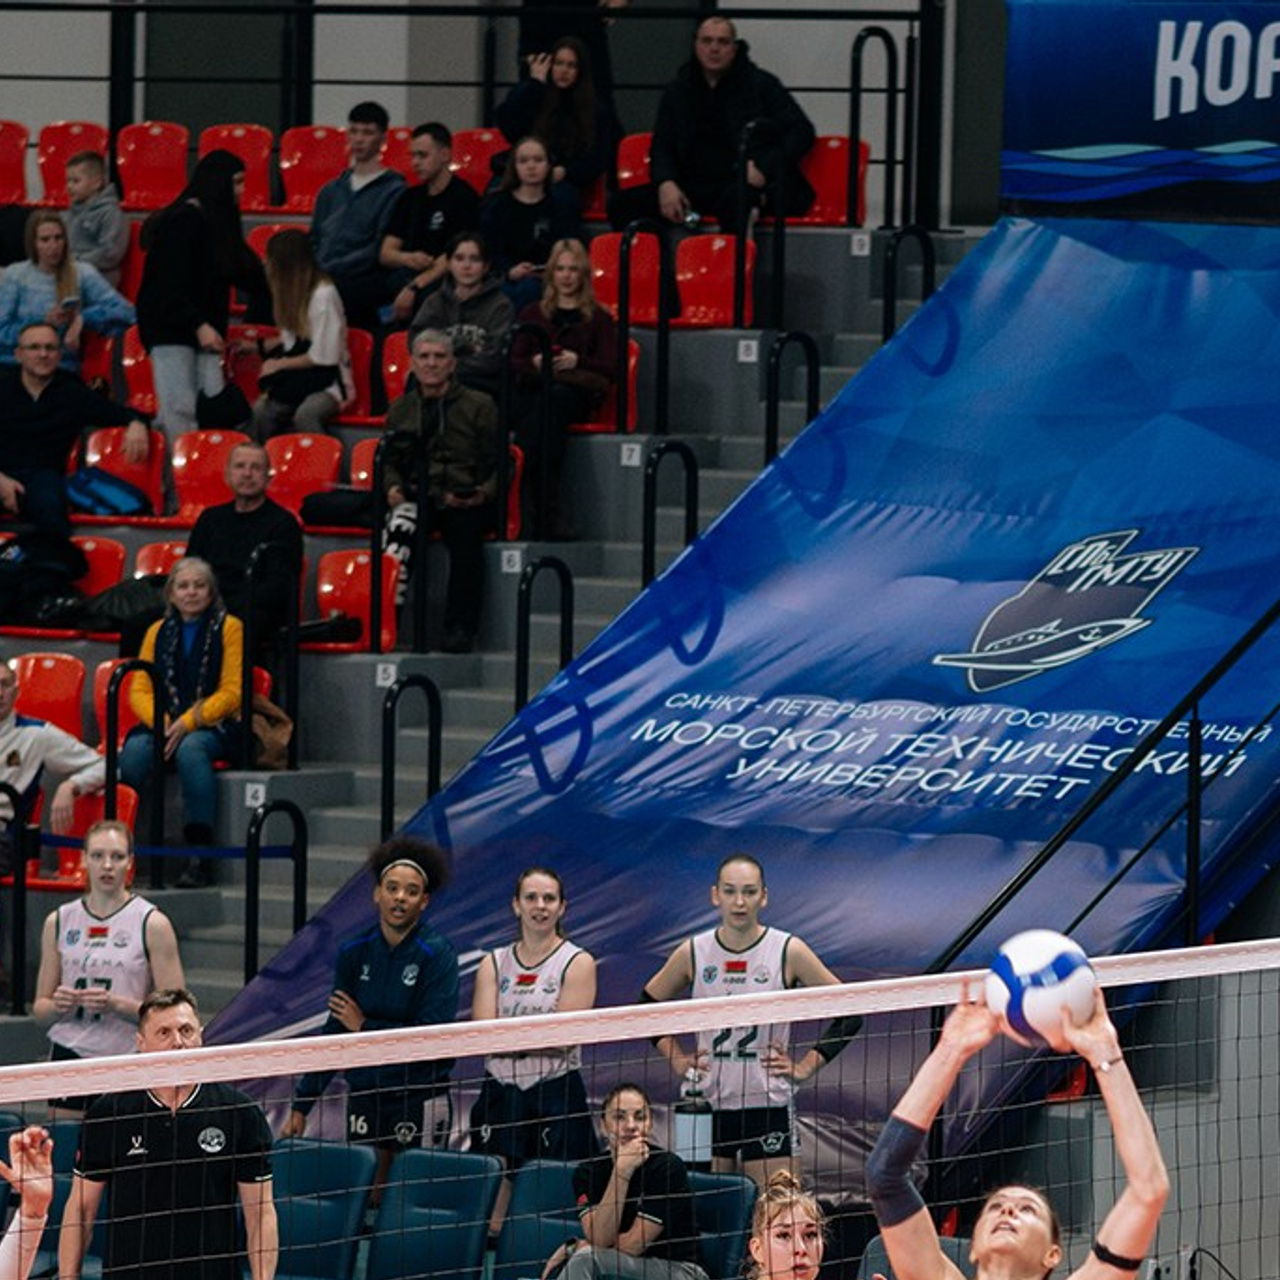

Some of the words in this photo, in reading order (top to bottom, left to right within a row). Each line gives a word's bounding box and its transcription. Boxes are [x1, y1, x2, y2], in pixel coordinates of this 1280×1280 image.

[631, 718, 874, 755] МОРСКОЙ
[886, 732, 1248, 779] ТЕХНИЧЕСКИЙ
[726, 757, 1090, 801] УНИВЕРСИТЕТ
[712, 1027, 758, 1058] 22
[350, 1115, 368, 1134] 16
